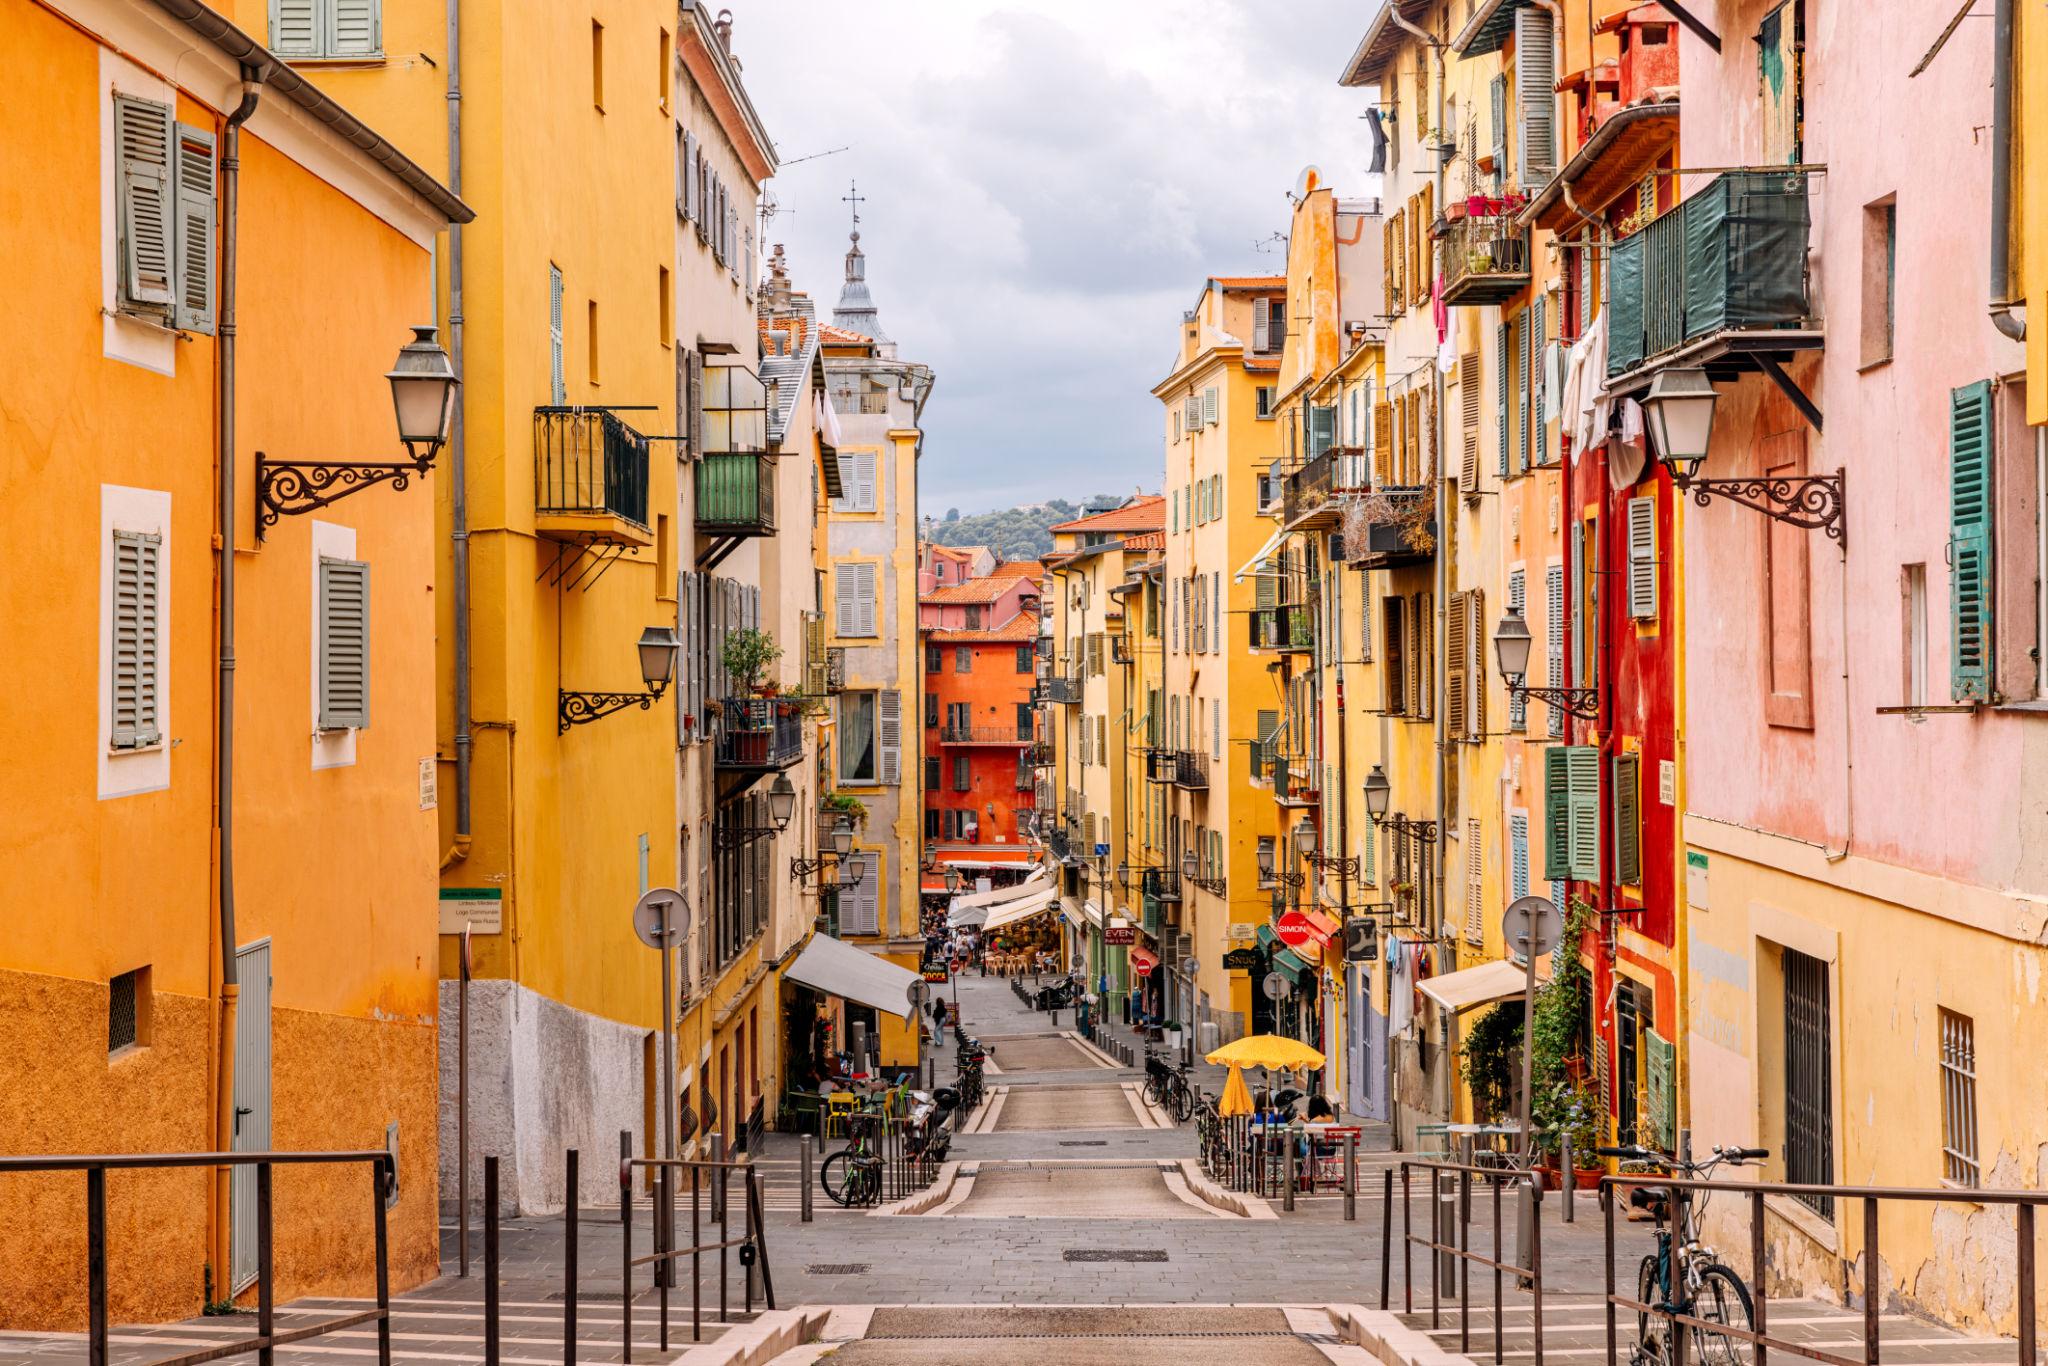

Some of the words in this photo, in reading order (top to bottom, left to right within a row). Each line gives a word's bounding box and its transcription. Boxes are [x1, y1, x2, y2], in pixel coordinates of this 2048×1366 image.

[1105, 929, 1134, 937] EVEN
[1279, 925, 1306, 933] SIMON
[1228, 955, 1256, 966] SNUG
[922, 972, 946, 981] SOCCA
